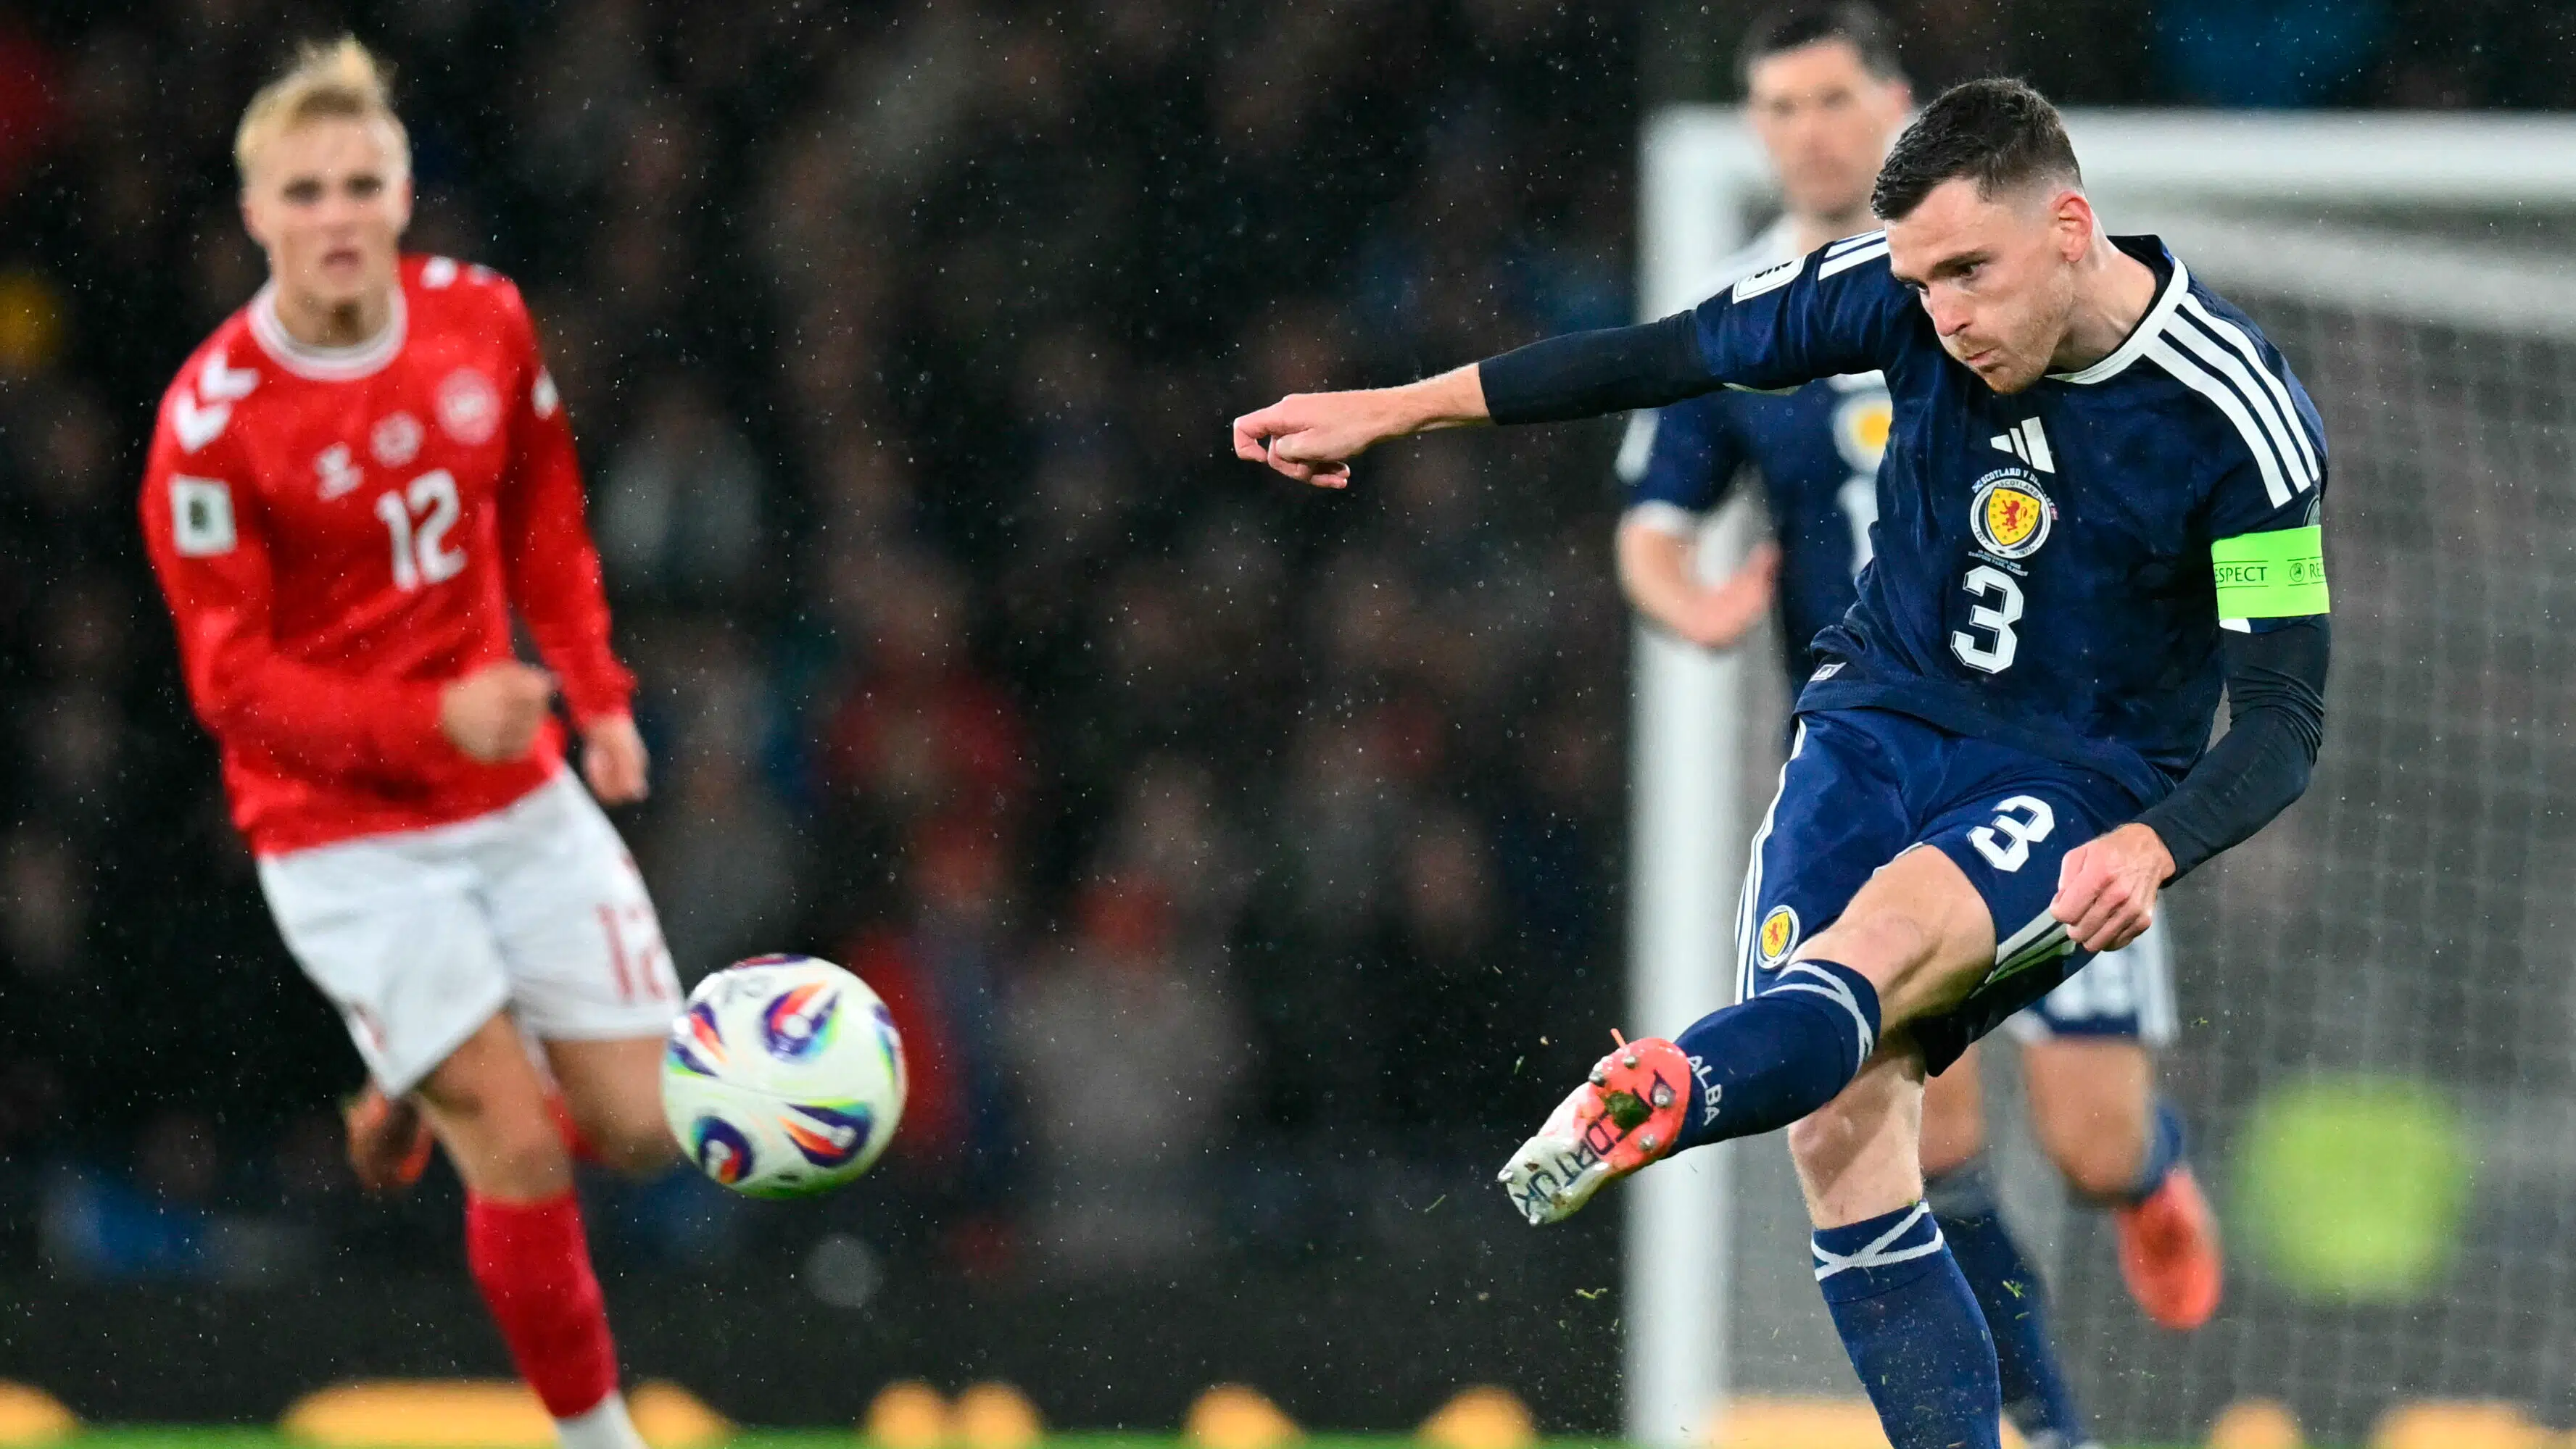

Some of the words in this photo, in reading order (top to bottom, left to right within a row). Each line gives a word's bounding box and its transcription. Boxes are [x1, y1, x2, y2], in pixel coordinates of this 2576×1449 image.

[1980, 468, 2021, 484] SCOTLAND
[2023, 470, 2029, 478] V
[2001, 480, 2039, 497] SCOTLAND
[374, 468, 468, 593] 12
[2215, 567, 2268, 583] ESPECT
[1950, 565, 2024, 674] 3
[1966, 795, 2055, 872] 3
[1686, 1055, 1722, 1126] ALBA
